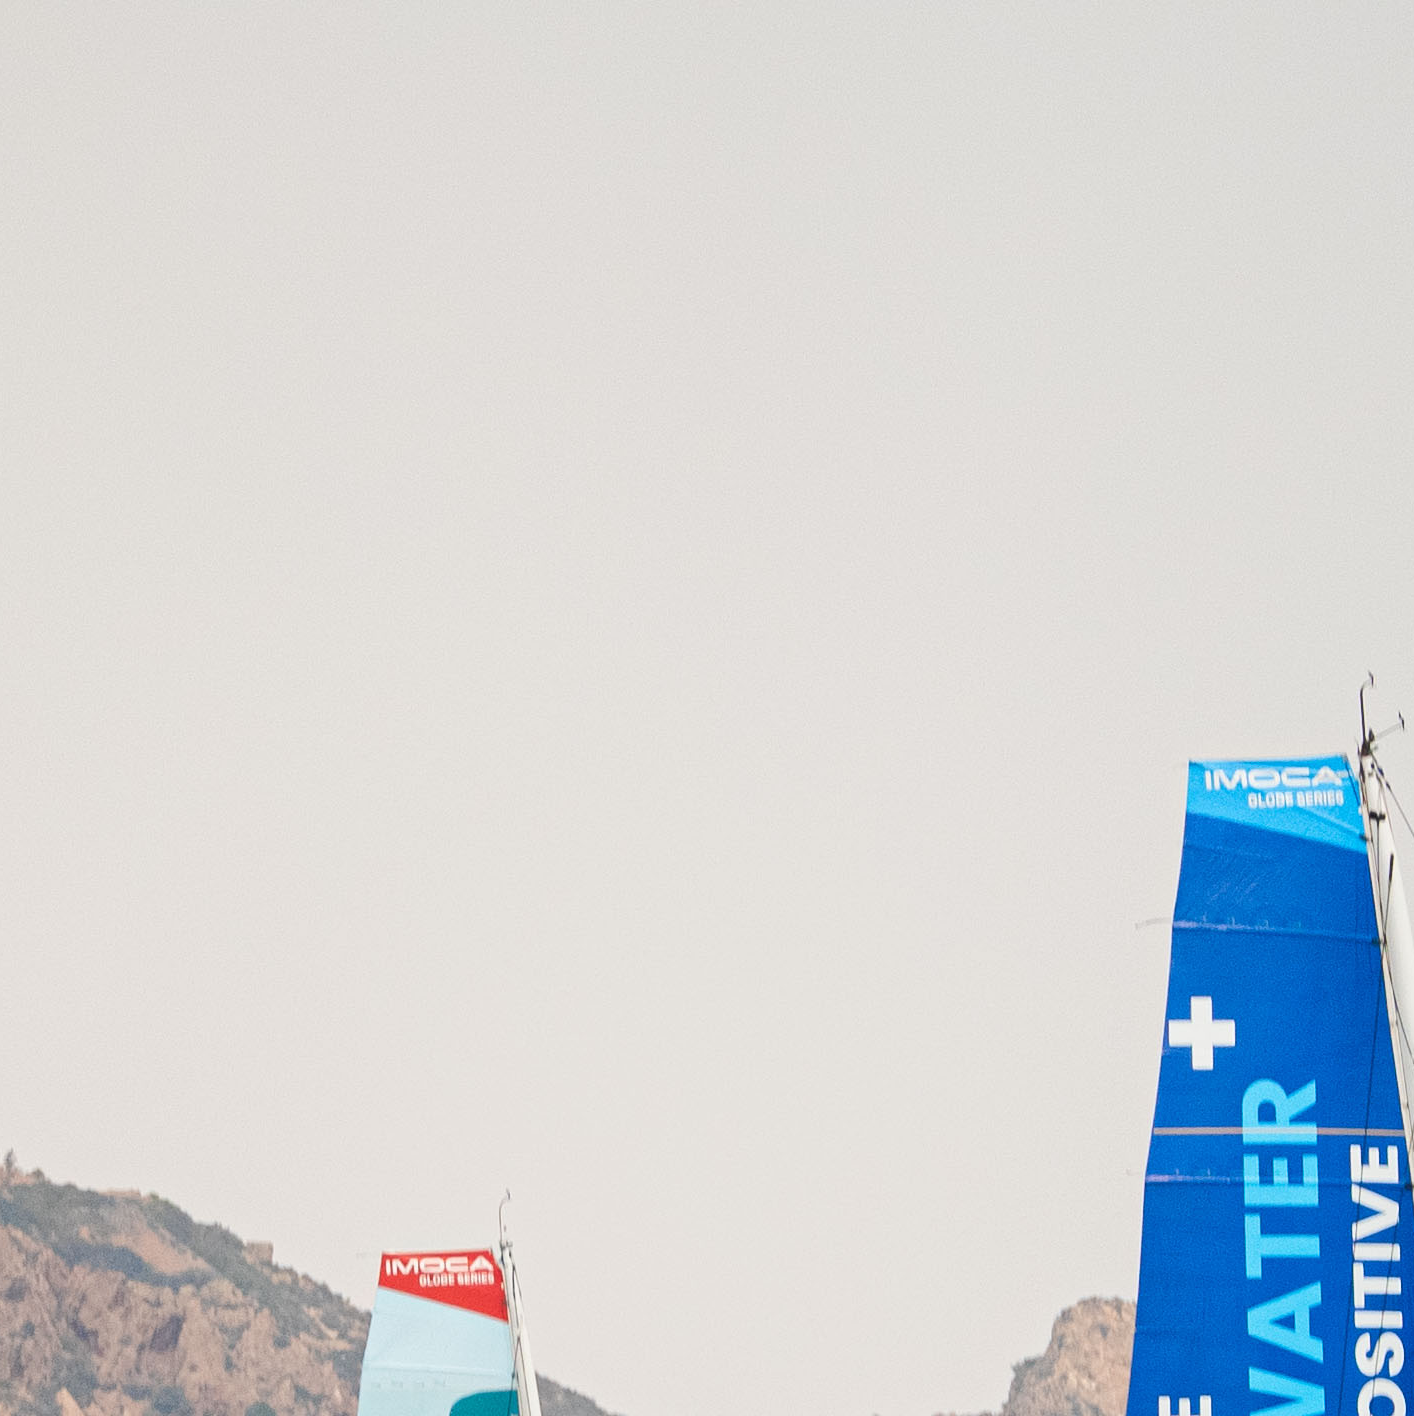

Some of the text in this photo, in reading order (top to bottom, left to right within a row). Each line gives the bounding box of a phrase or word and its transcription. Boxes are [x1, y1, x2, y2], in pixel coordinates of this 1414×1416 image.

[1205, 765, 1343, 791] IMOCA
[1247, 790, 1344, 809] GLOBE SERIES
[385, 1255, 494, 1276] IMOCA
[419, 1271, 495, 1288] GLOBE SERIES
